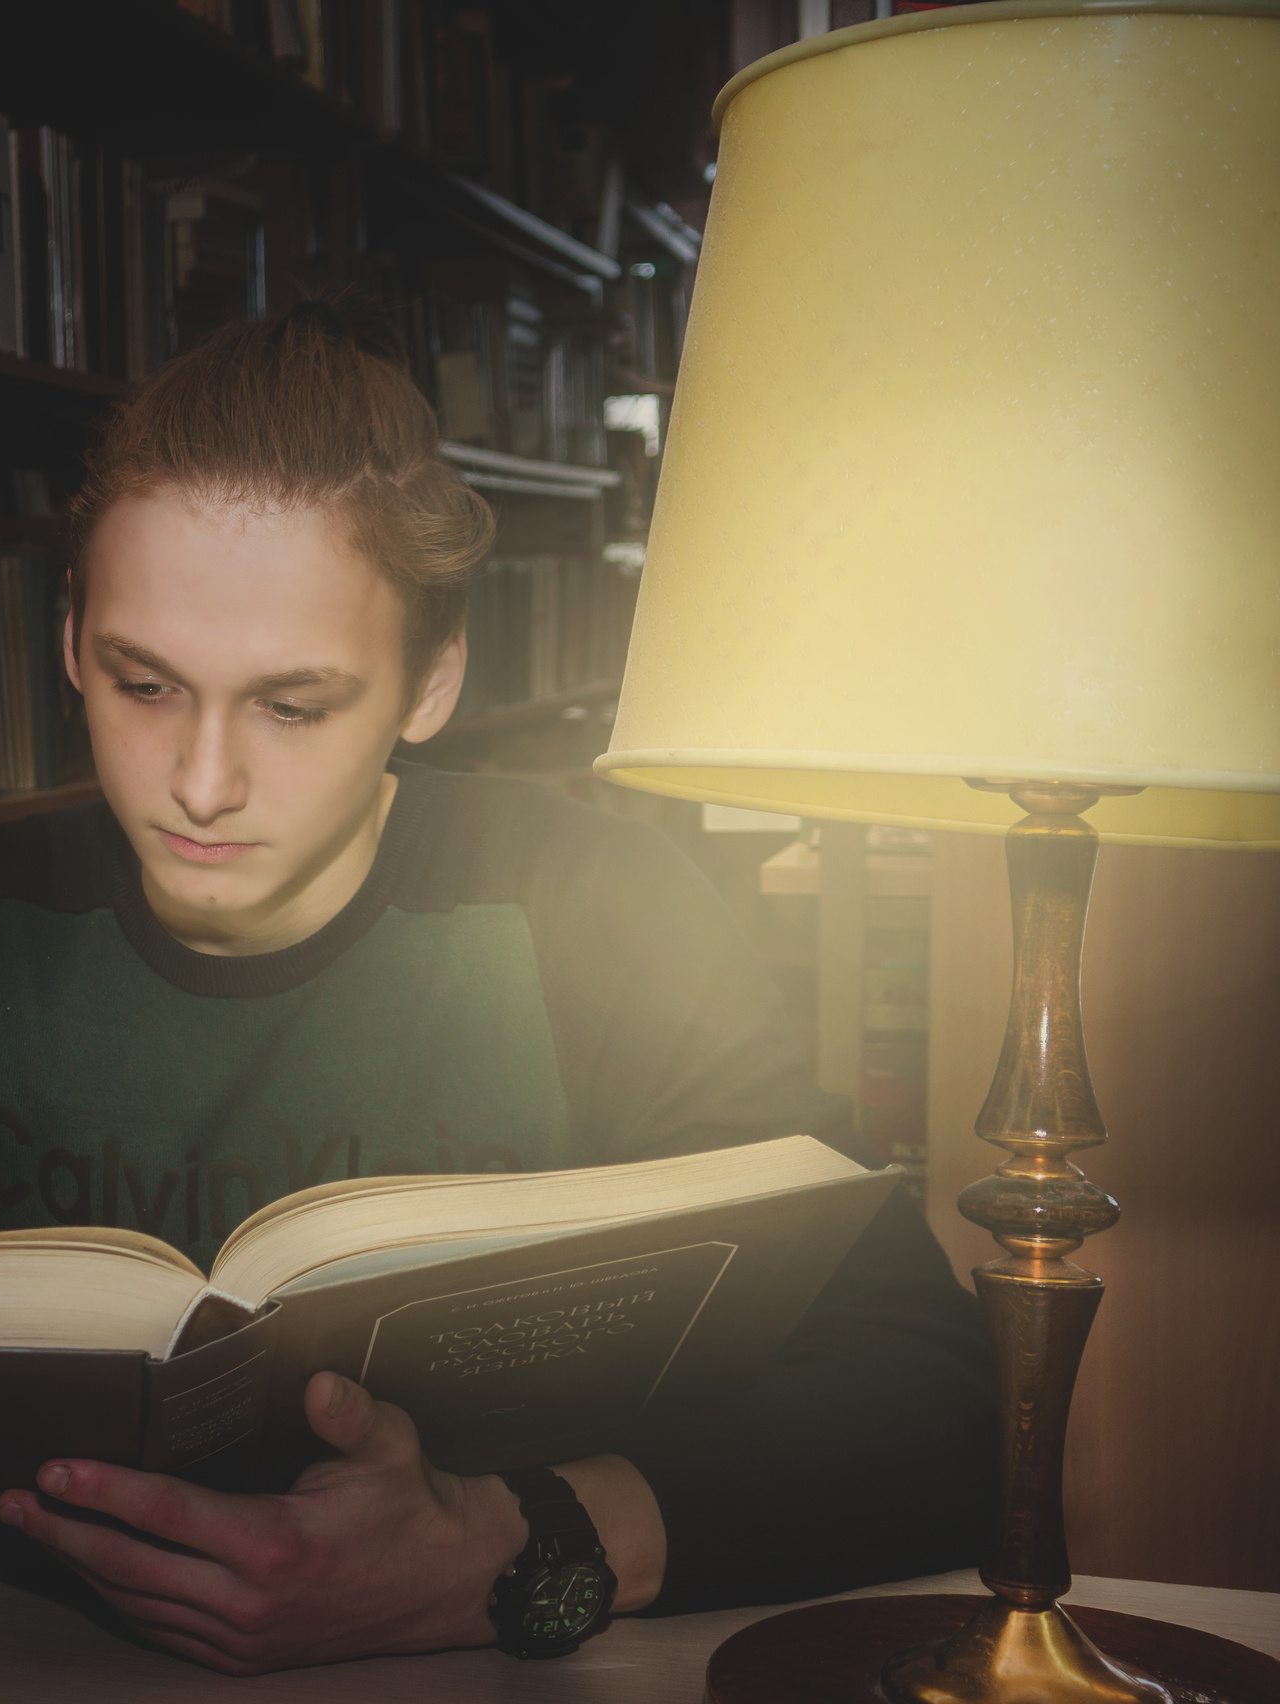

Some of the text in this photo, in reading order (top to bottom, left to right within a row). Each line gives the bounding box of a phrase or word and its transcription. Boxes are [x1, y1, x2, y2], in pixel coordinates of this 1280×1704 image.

[429, 1289, 657, 1344] ТОЛКОВЫЙ
[483, 1291, 540, 1306] ОЖЕГОВ
[428, 1323, 635, 1372] РУССКОГО
[447, 1313, 626, 1355] СЛОВАРЬ
[459, 1345, 586, 1378] ЯЗЫКА
